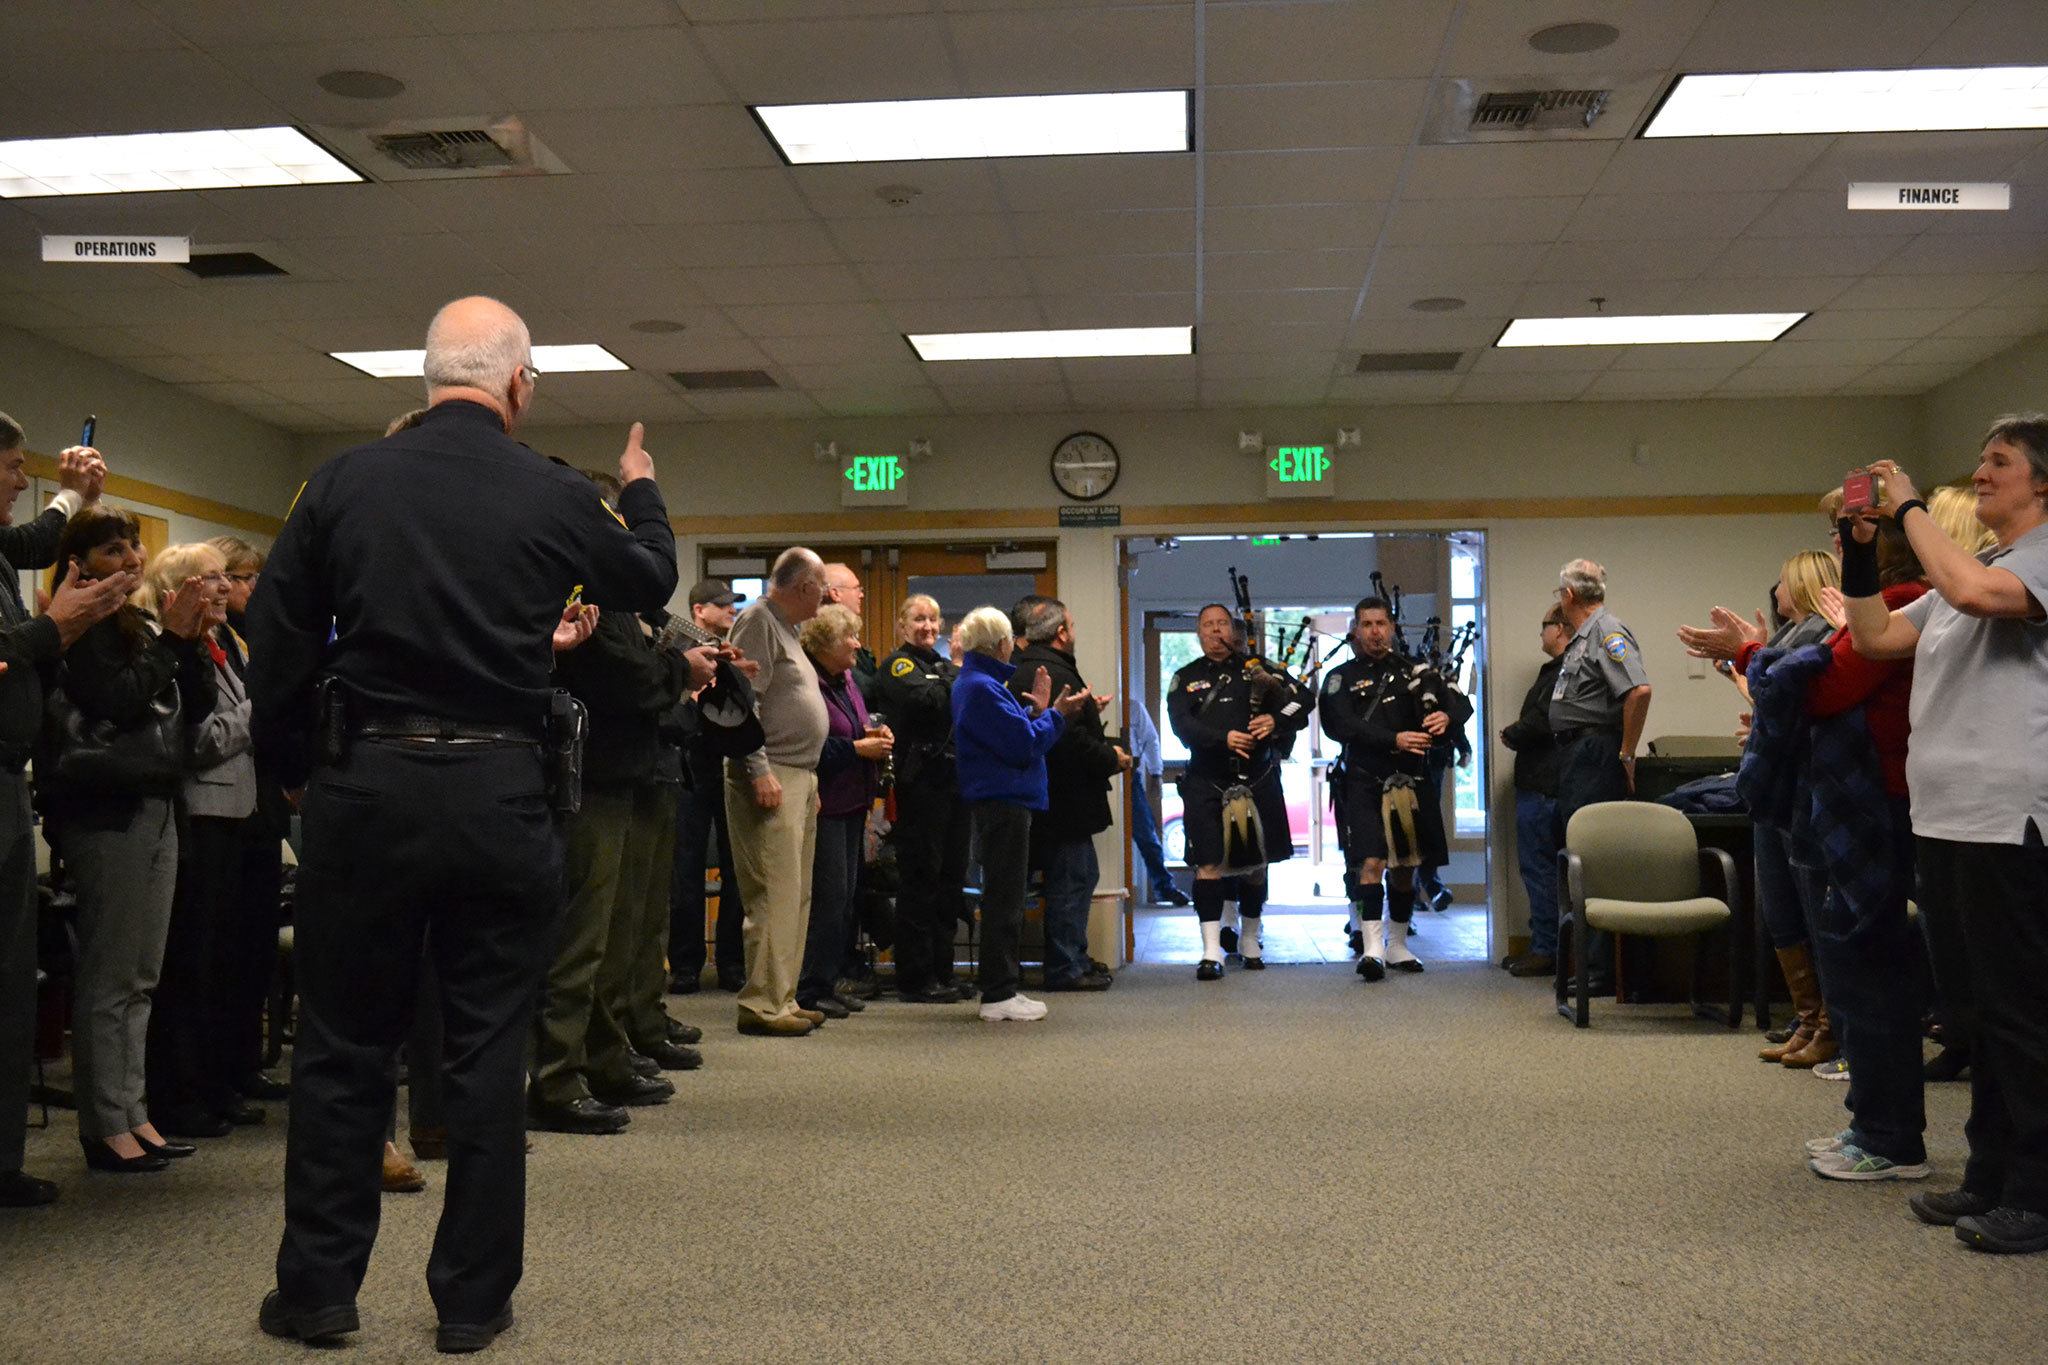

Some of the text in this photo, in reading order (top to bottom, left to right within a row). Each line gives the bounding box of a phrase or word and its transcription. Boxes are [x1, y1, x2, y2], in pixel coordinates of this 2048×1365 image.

[1899, 188, 1960, 204] FINANCE
[75, 241, 157, 257] OPERATIONS
[853, 455, 899, 491] EXIT
[1278, 446, 1325, 482] EXIT
